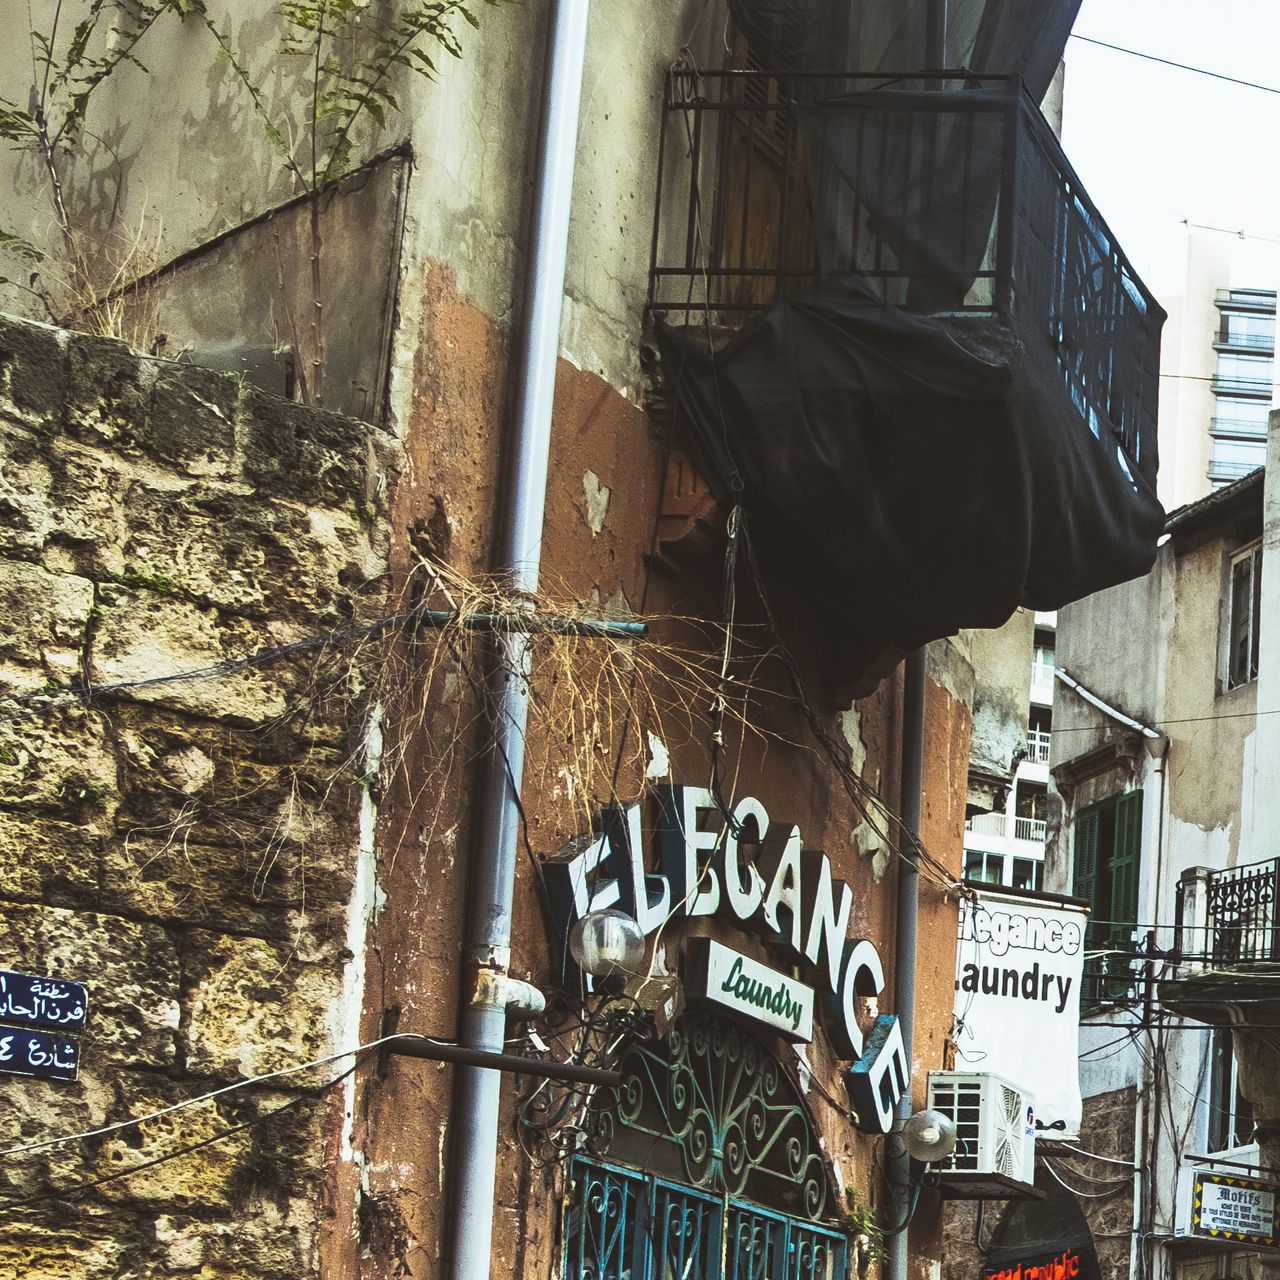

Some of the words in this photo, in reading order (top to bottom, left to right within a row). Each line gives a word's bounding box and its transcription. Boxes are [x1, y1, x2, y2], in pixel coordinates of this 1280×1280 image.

[564, 785, 910, 1133] ELEGANCE
[0, 993, 46, 1019] الحاي
[721, 956, 803, 1031] Laundry
[954, 962, 1072, 1013] aundry
[28, 1039, 76, 1069] شارع
